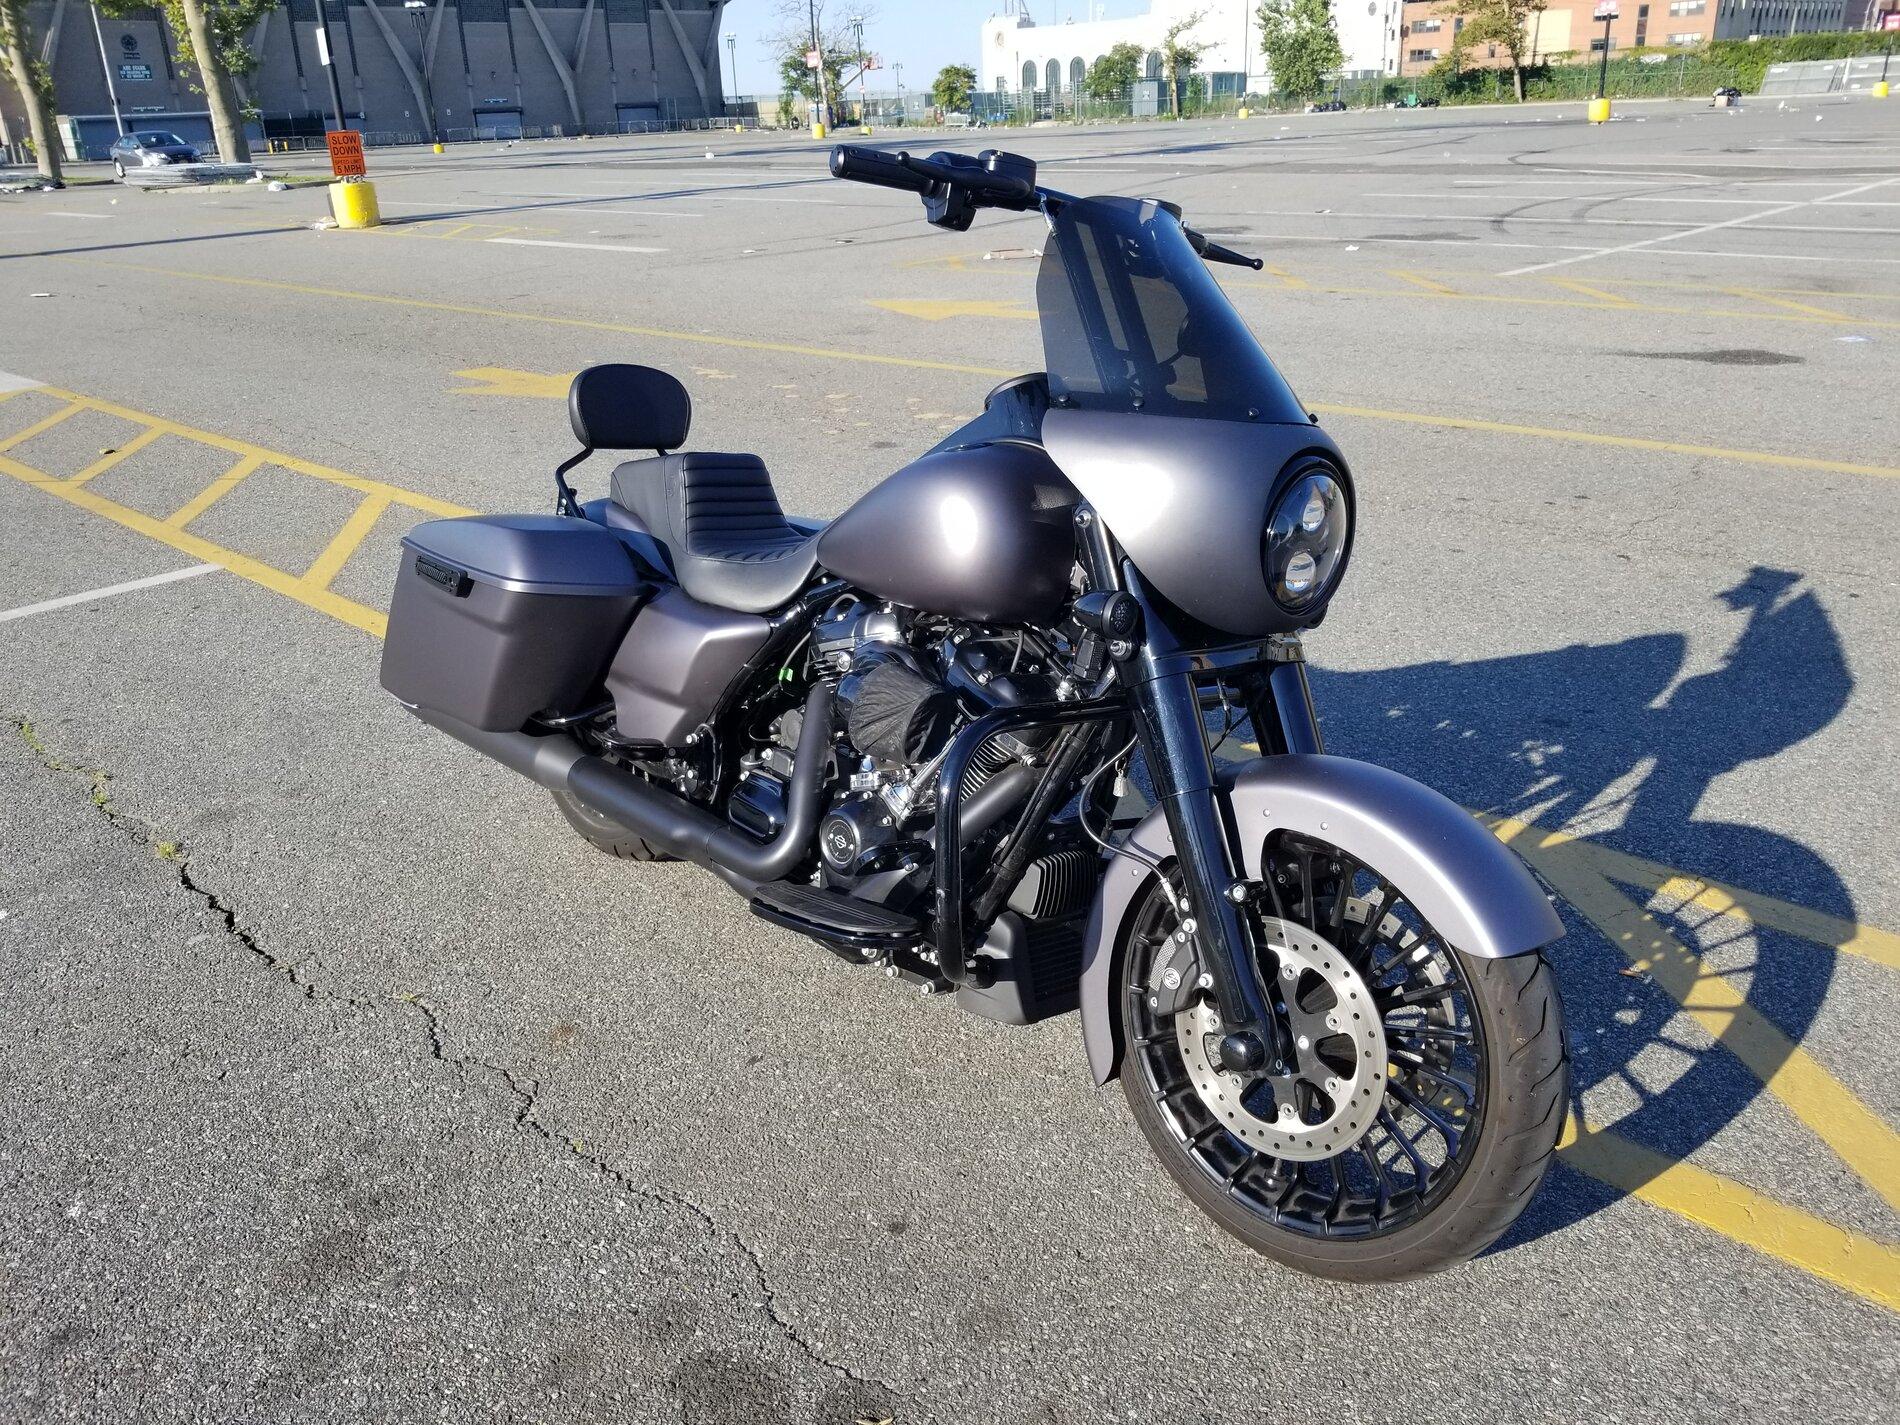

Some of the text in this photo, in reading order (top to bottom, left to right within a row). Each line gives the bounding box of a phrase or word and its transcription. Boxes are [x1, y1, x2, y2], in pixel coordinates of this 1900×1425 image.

[331, 136, 356, 145] SLOW
[332, 146, 360, 155] DOWN
[337, 164, 362, 174] 5 MPH
